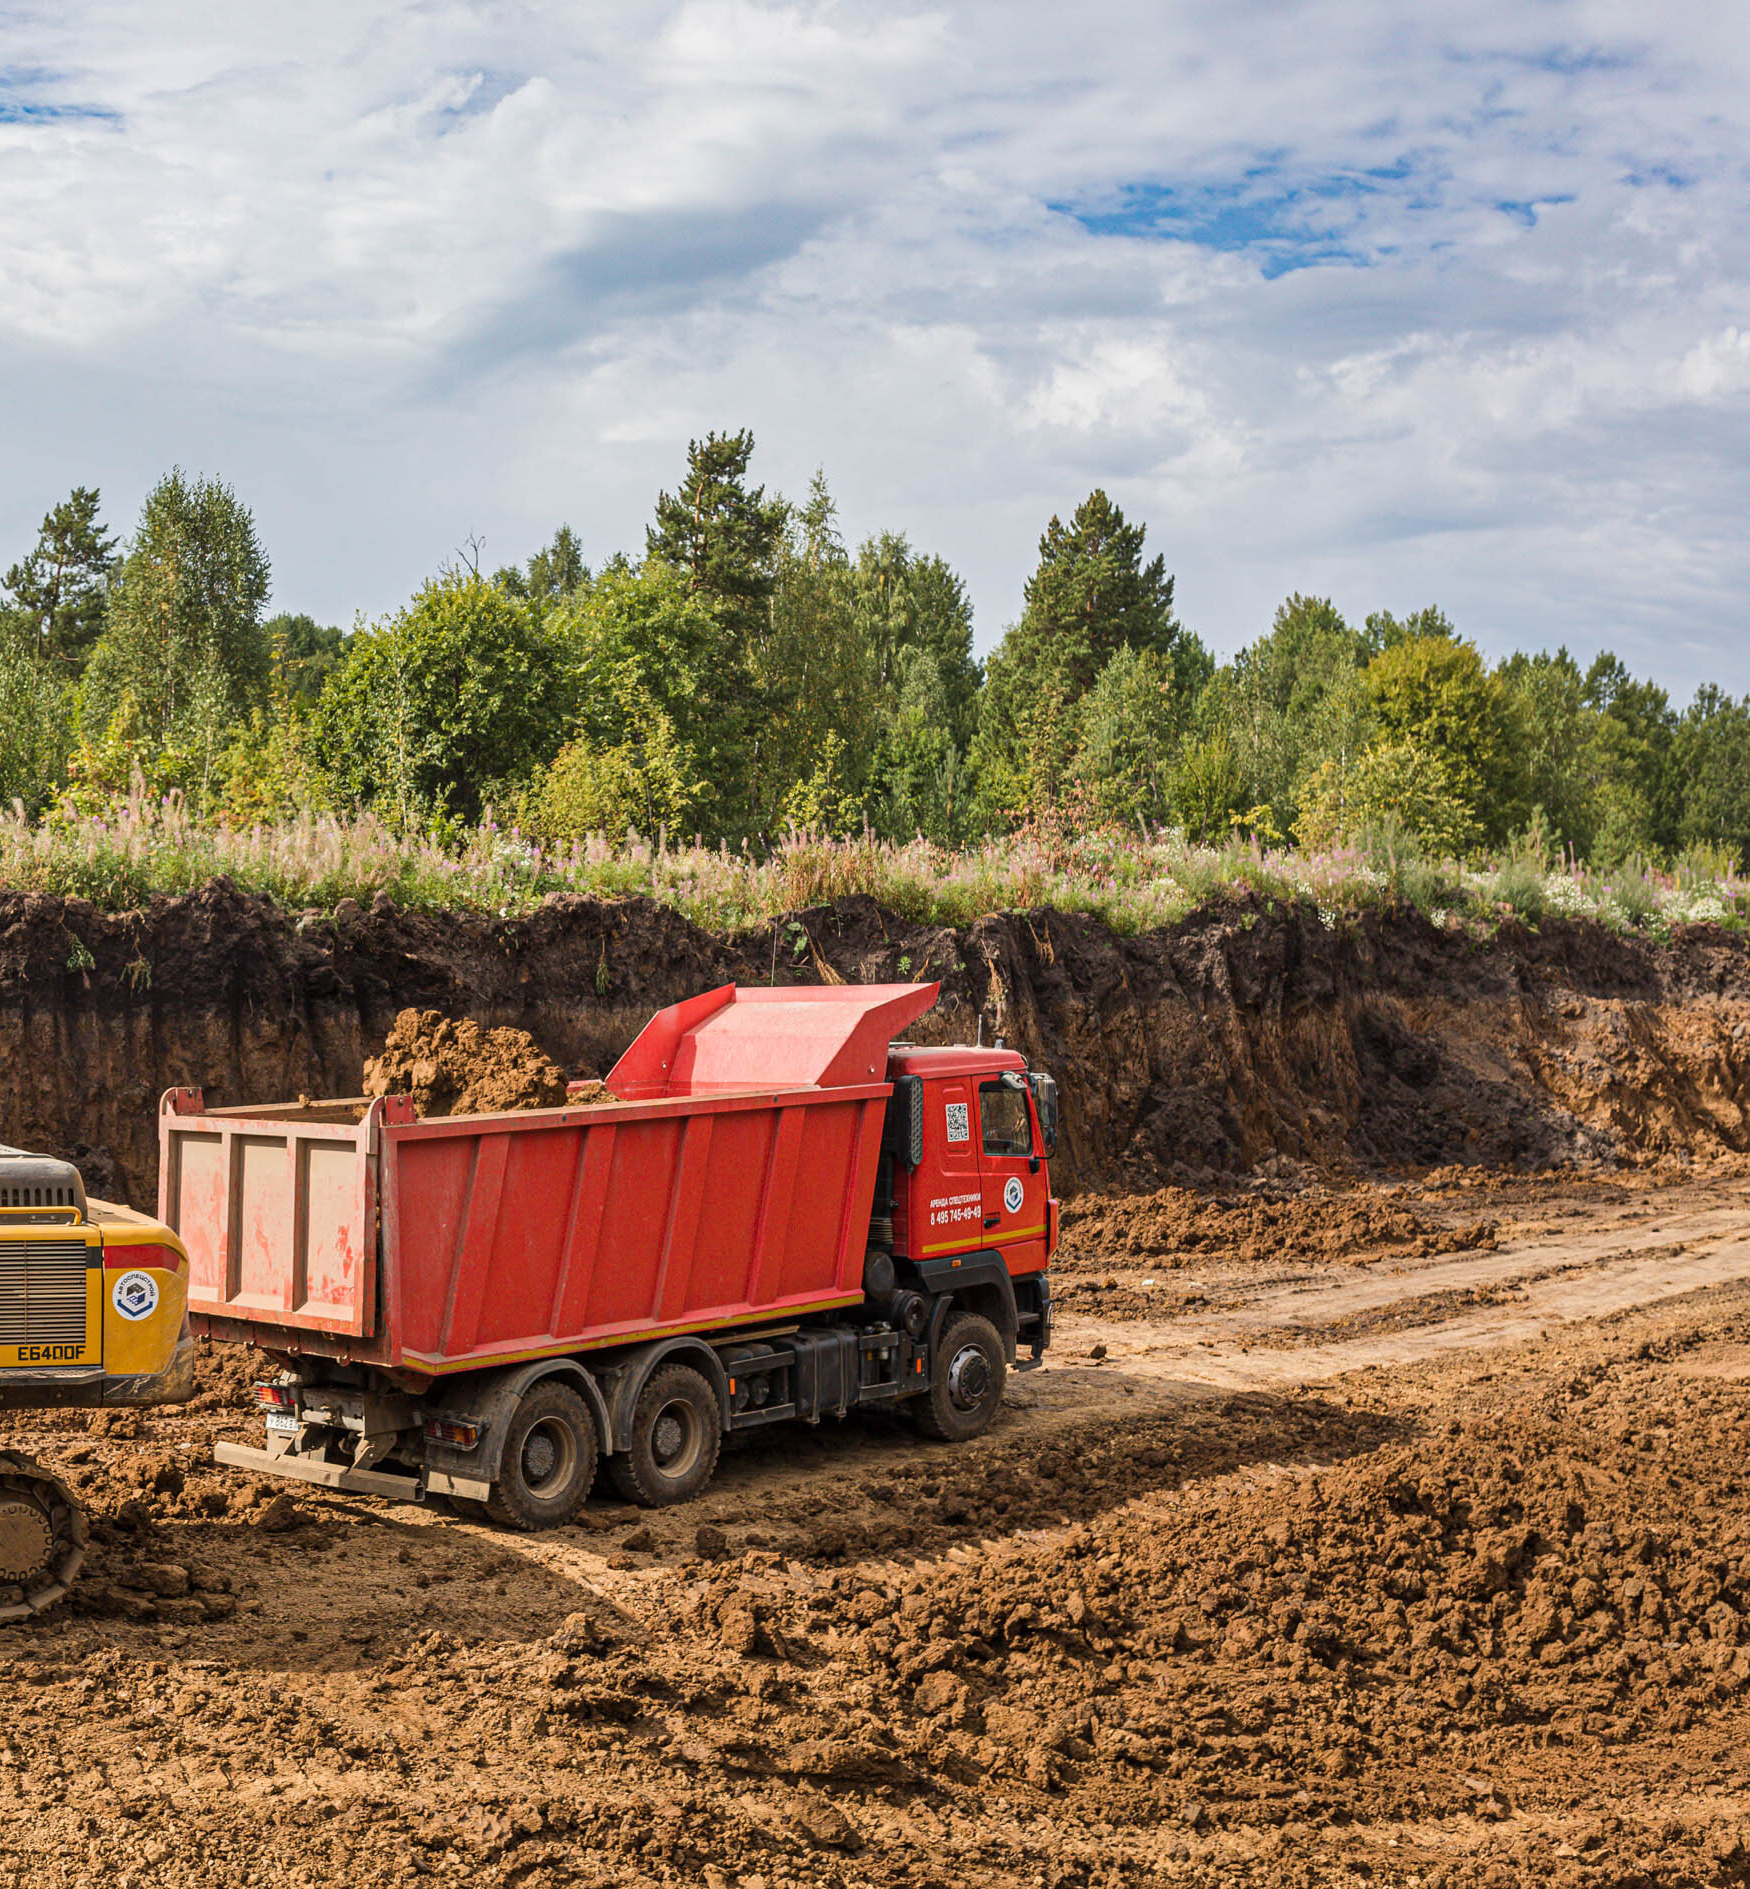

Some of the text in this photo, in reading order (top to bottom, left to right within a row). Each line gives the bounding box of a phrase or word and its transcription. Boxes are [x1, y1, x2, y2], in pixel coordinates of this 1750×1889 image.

[930, 1192, 981, 1208] АРЕНДА СПЕЦТЕХНИКИ
[930, 1205, 982, 1226] 8 495 745-49-49
[118, 1273, 155, 1297] АВТОСПЕЦСТРОЙ
[18, 1345, 86, 1361] E6400F
